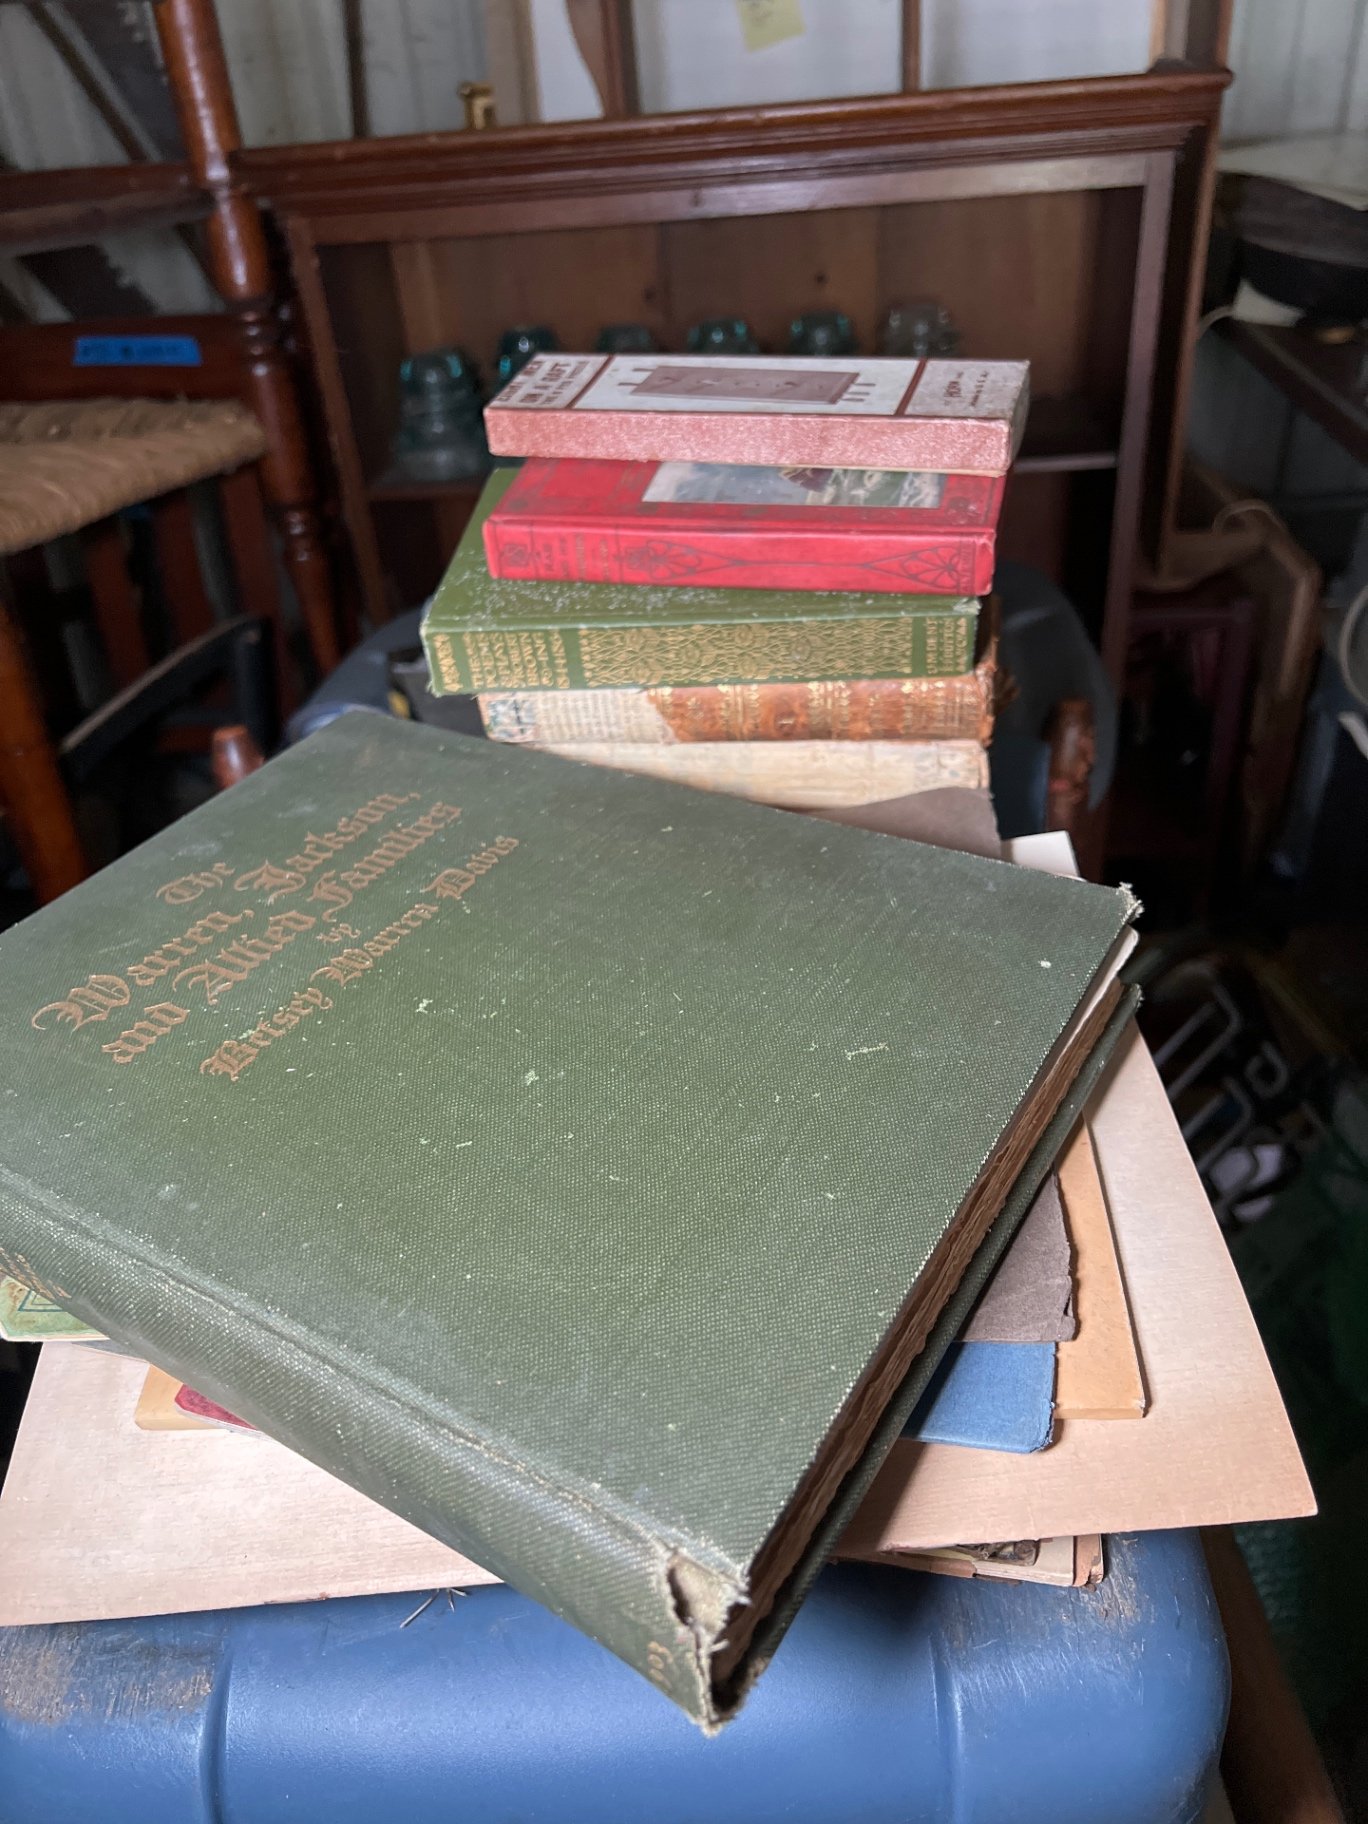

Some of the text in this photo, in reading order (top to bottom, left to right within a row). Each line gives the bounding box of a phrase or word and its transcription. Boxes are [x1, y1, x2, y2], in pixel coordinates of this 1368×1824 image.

[476, 632, 498, 689] POEMS
[489, 632, 511, 675] PLAYS
[517, 632, 540, 686] BROWN
[155, 861, 236, 905] The
[31, 792, 422, 1035] Warren, Jackson,
[101, 801, 463, 1066] and Allied Families
[315, 922, 362, 943] by
[199, 835, 520, 1082] Betsey Warren Davis
